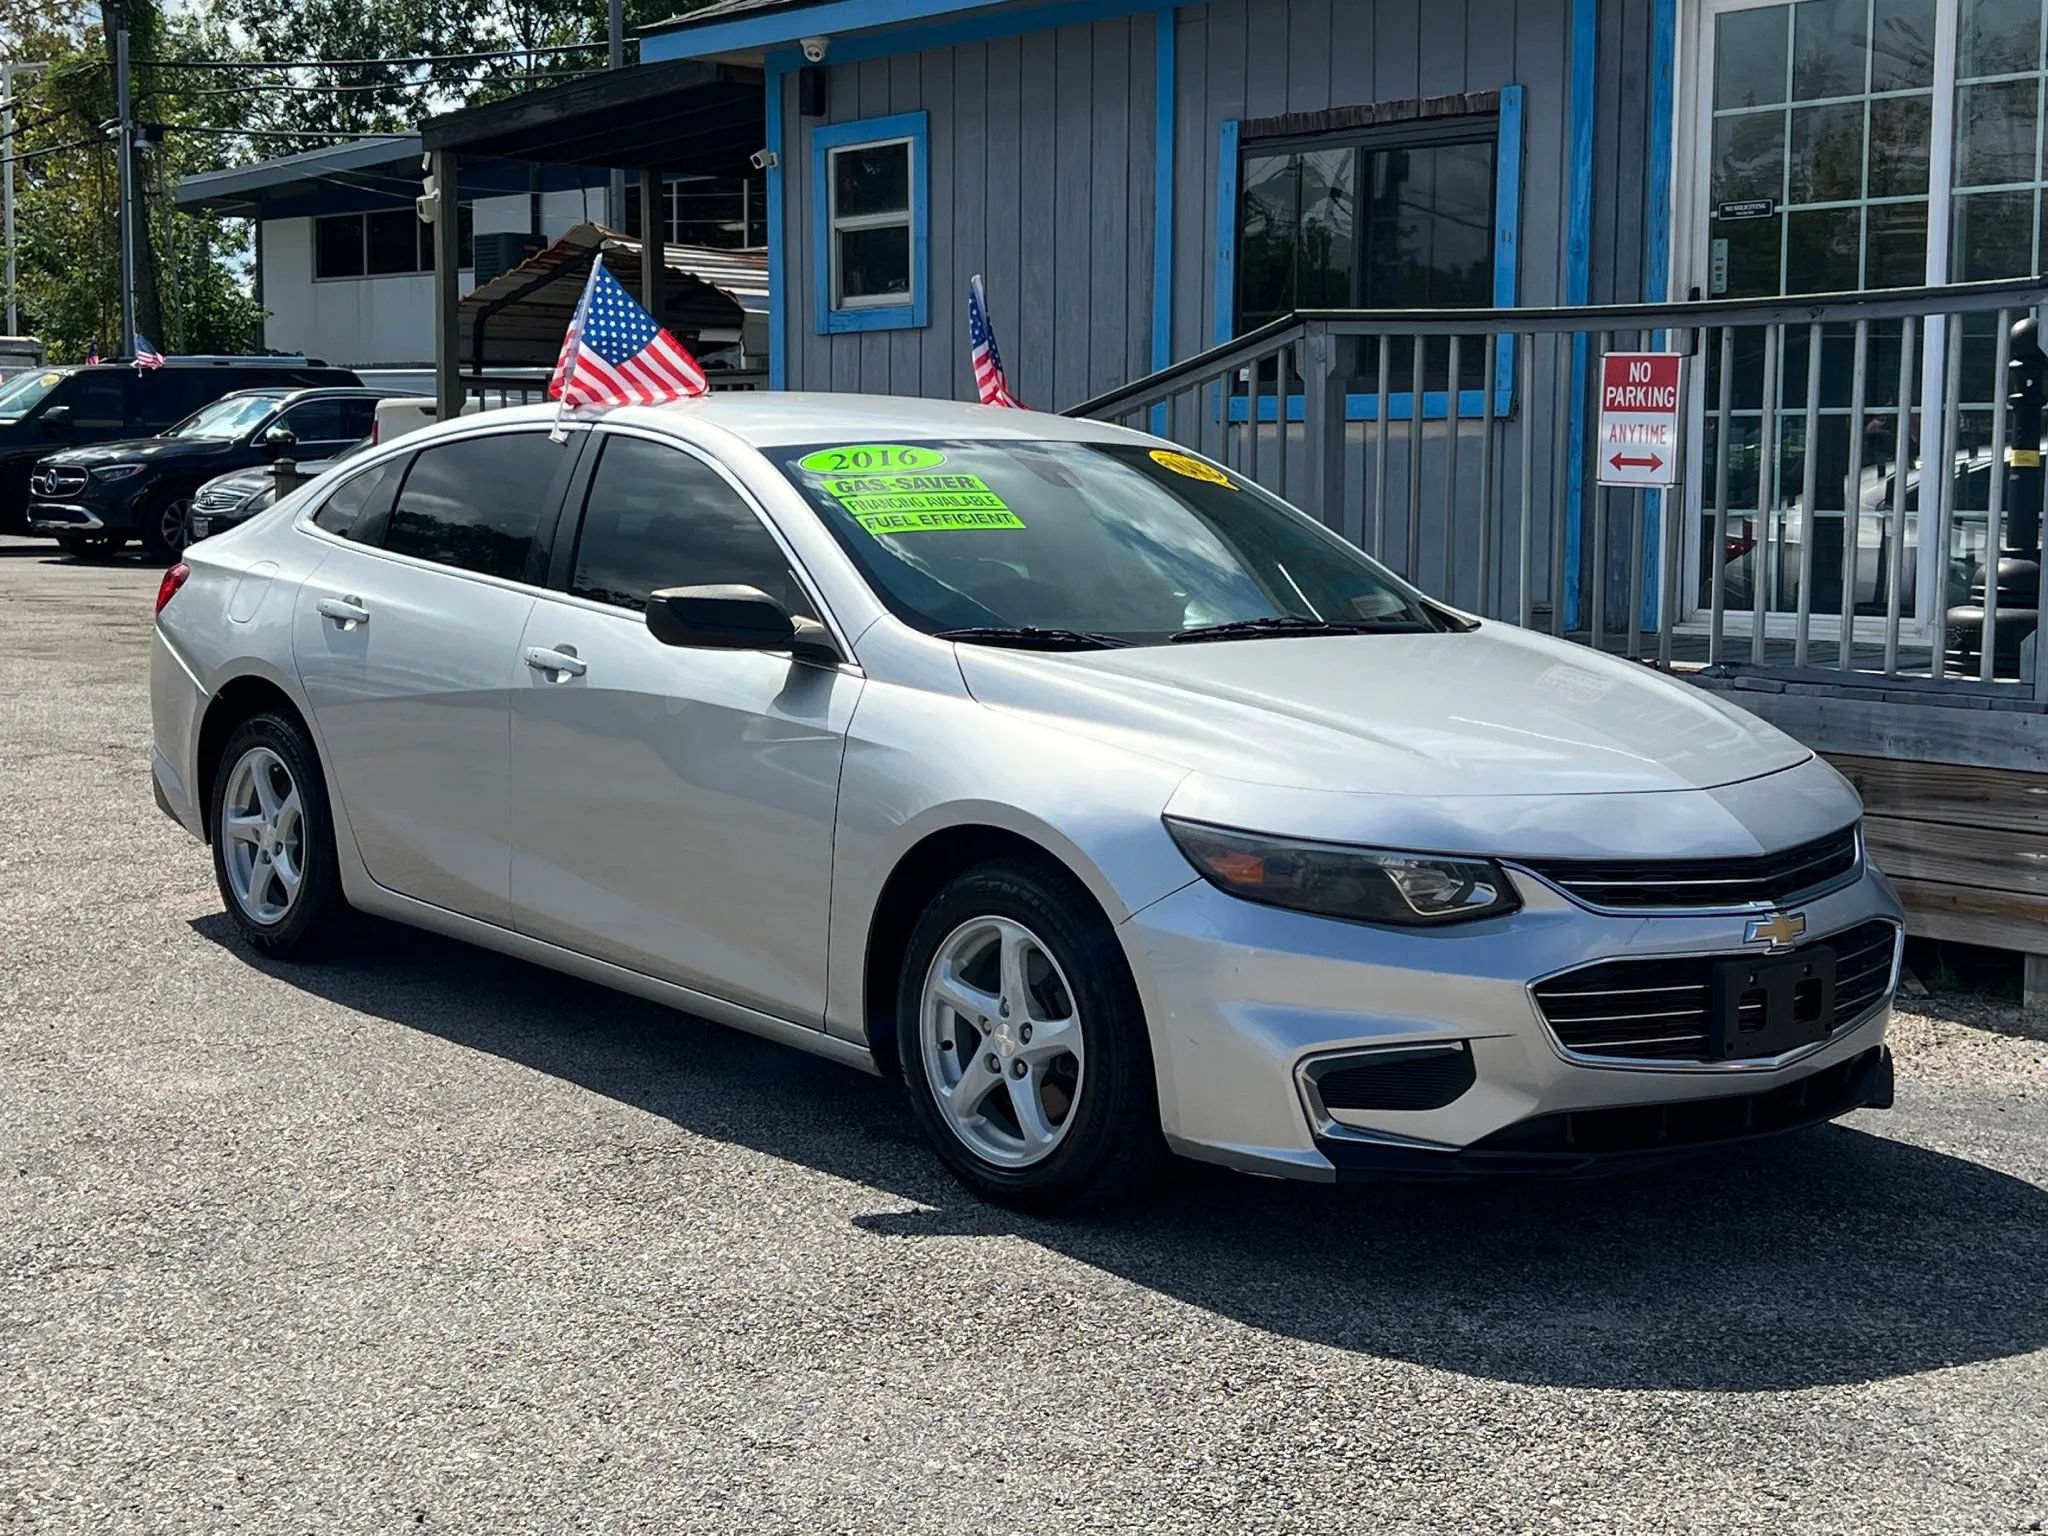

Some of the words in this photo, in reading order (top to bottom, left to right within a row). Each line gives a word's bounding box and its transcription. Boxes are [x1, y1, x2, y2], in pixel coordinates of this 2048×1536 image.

[1629, 361, 1652, 383] NO
[1606, 386, 1675, 408] PARKING
[1609, 423, 1667, 445] ANYTIME
[828, 449, 918, 471] 2016
[834, 475, 975, 494] GAS-SAVER
[847, 496, 924, 512] FINANCING
[927, 494, 999, 509] AVAILABLE
[864, 515, 915, 530] FUEL
[918, 513, 1014, 526] EFFICIENT
